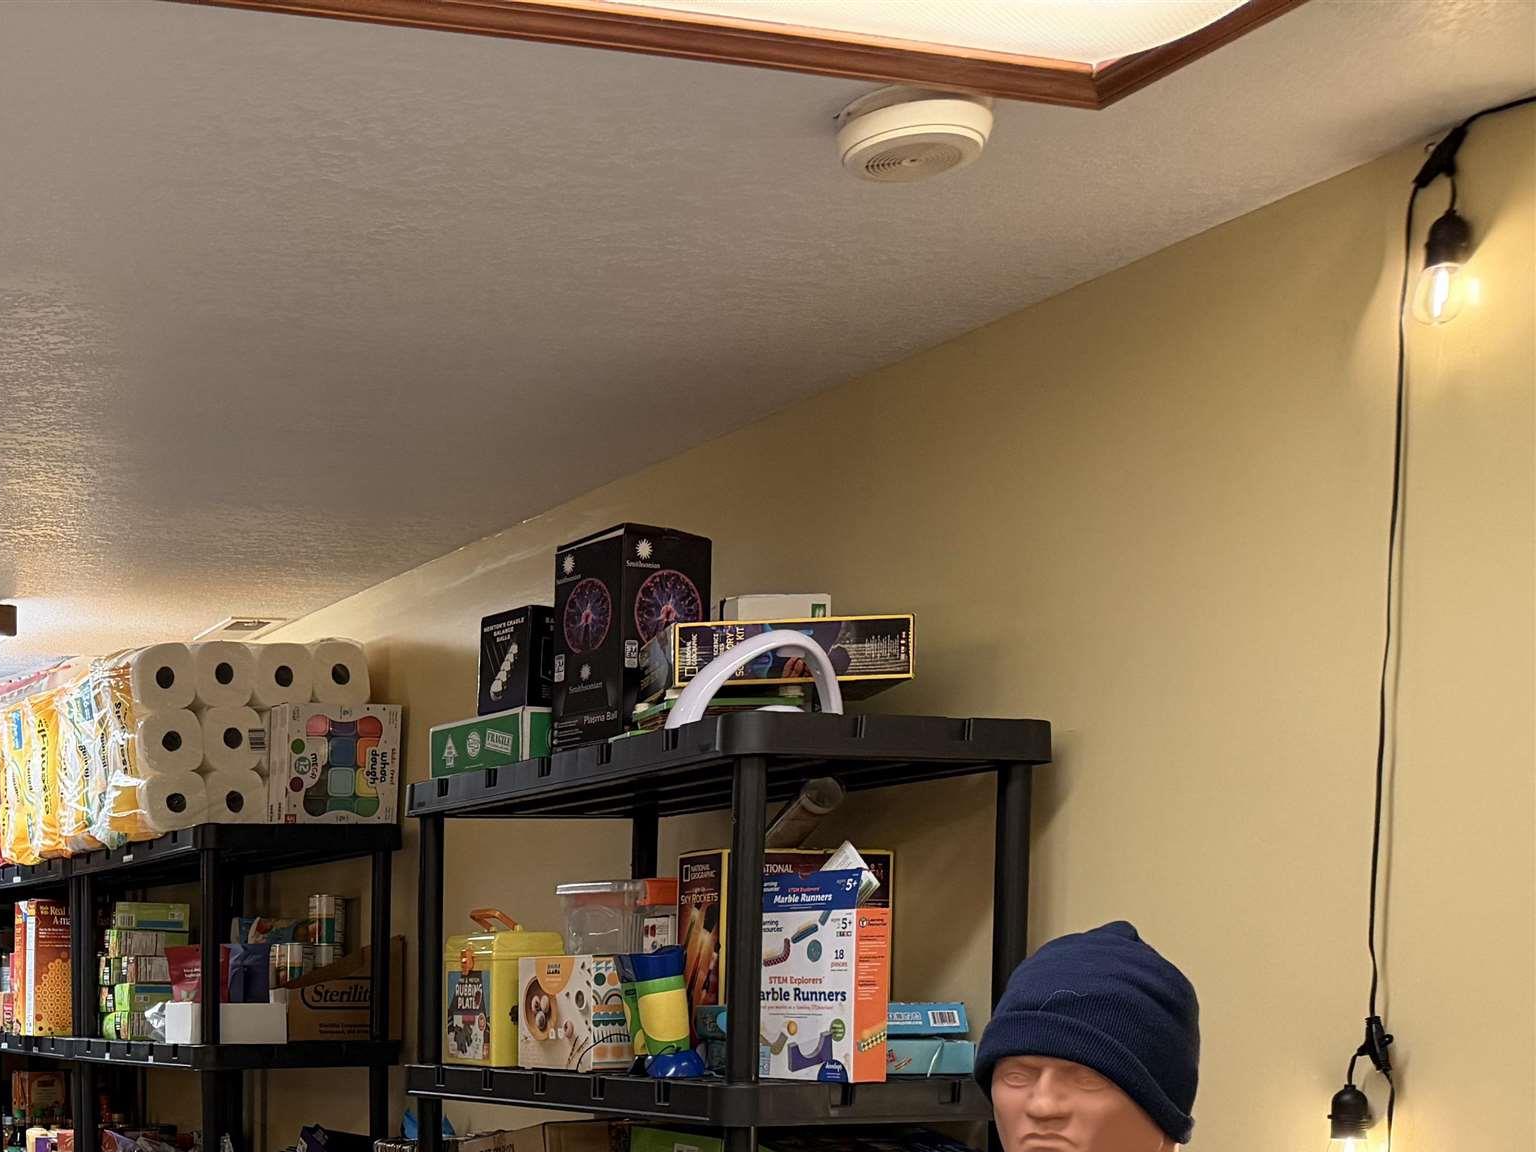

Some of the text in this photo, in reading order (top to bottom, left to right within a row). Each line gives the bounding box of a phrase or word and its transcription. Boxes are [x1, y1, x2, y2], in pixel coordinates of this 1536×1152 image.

[582, 710, 619, 726] Plasma Ball
[487, 731, 512, 747] FRAGILE
[366, 749, 379, 785] dough
[380, 751, 389, 784] whoa
[764, 863, 794, 874] TIONAL
[845, 878, 858, 892] 5+
[774, 893, 833, 904] Marble Runners
[841, 917, 853, 930] 5+
[834, 949, 845, 960] 18
[768, 976, 788, 985] STEM
[310, 982, 372, 1004] Sterilit
[455, 984, 483, 996] RUBBING
[760, 987, 848, 1002] arble Runners
